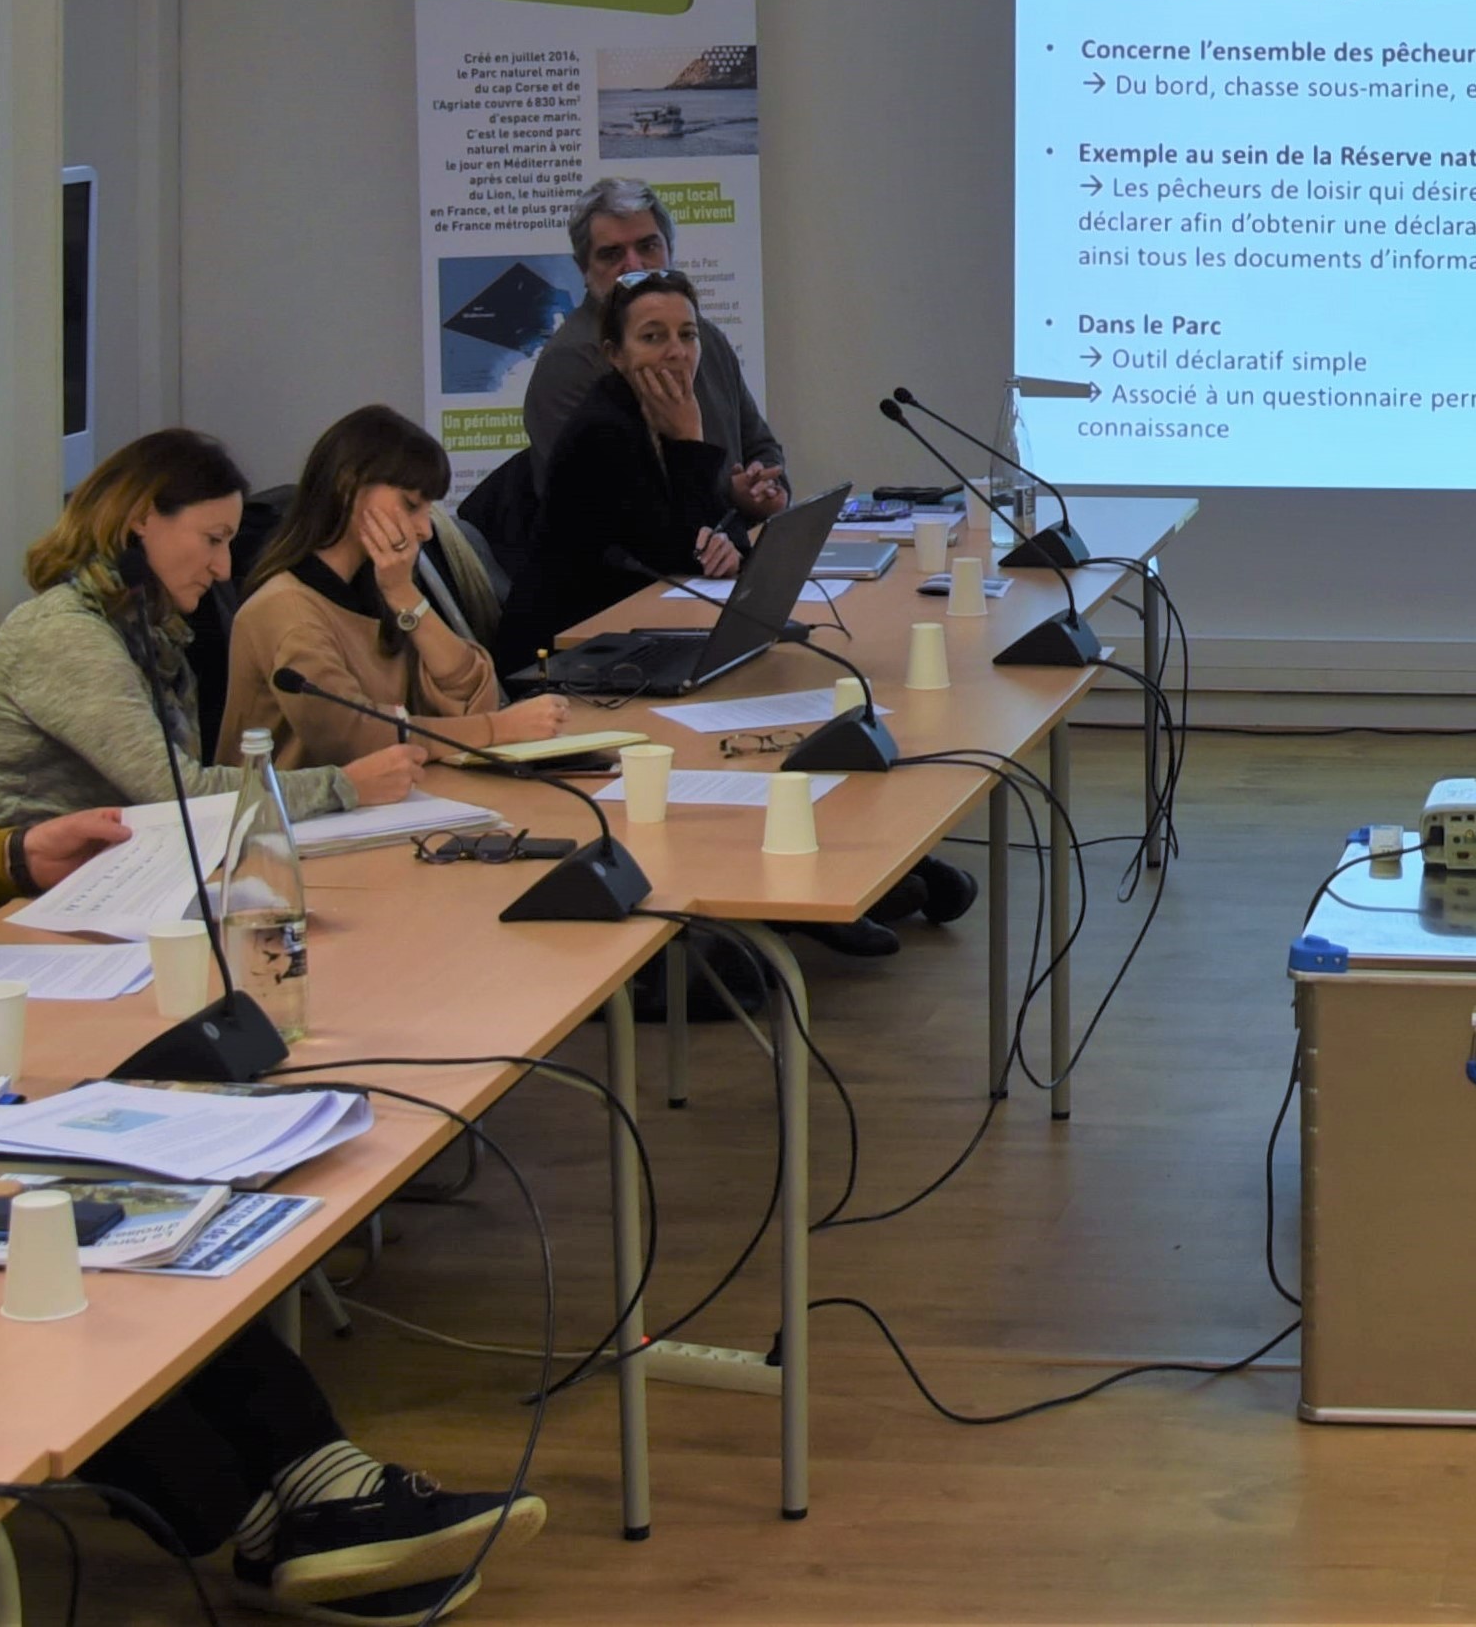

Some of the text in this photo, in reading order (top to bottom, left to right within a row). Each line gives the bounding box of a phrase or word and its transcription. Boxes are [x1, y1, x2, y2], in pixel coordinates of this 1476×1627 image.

[464, 50, 580, 65] Créé en juillet 2016,
[1081, 39, 1191, 60] Concerne
[1200, 40, 1326, 62] l'ensemble
[1333, 42, 1373, 62] des
[457, 67, 580, 79] le Parc naturel marin
[474, 81, 580, 95] du cap Corse et de
[1116, 75, 1146, 95] Du
[1155, 74, 1215, 99] bord,
[1224, 75, 1299, 97] chasse
[1308, 78, 1456, 102] sous-marine,
[543, 112, 581, 122] marin.
[498, 129, 510, 139] le
[512, 127, 553, 139] second
[556, 128, 581, 139] parc
[1079, 143, 1178, 168] Exemple
[1186, 149, 1213, 164] au
[1222, 145, 1268, 165] sein
[1276, 144, 1304, 165] de
[1313, 145, 1332, 166] la
[1341, 145, 1432, 167] Réserve
[687, 187, 719, 202] local
[1113, 178, 1149, 198] Les
[1157, 177, 1262, 202] pêcheurs
[1270, 179, 1299, 200] de
[1307, 179, 1362, 200] loisir
[1369, 181, 1404, 205] qui
[693, 205, 733, 220] vivent
[1078, 210, 1173, 232] déclarer
[1180, 211, 1222, 233] afin
[1231, 212, 1336, 234] d'obtenir
[1344, 219, 1387, 235] une
[1078, 246, 1129, 266] ainsi
[1137, 248, 1187, 267] tous
[1196, 246, 1226, 267] les
[1234, 247, 1362, 269] documents
[1079, 314, 1221, 336] Dans le Parc
[1112, 348, 1367, 376] Outil déclaratif simple
[1111, 384, 1197, 405] Associé
[1206, 384, 1218, 405] à
[1226, 390, 1254, 405] un
[1262, 386, 1422, 410] questionnaire
[444, 414, 461, 430] Un
[1077, 417, 1230, 439] connaissance
[444, 432, 503, 451] grandeur
